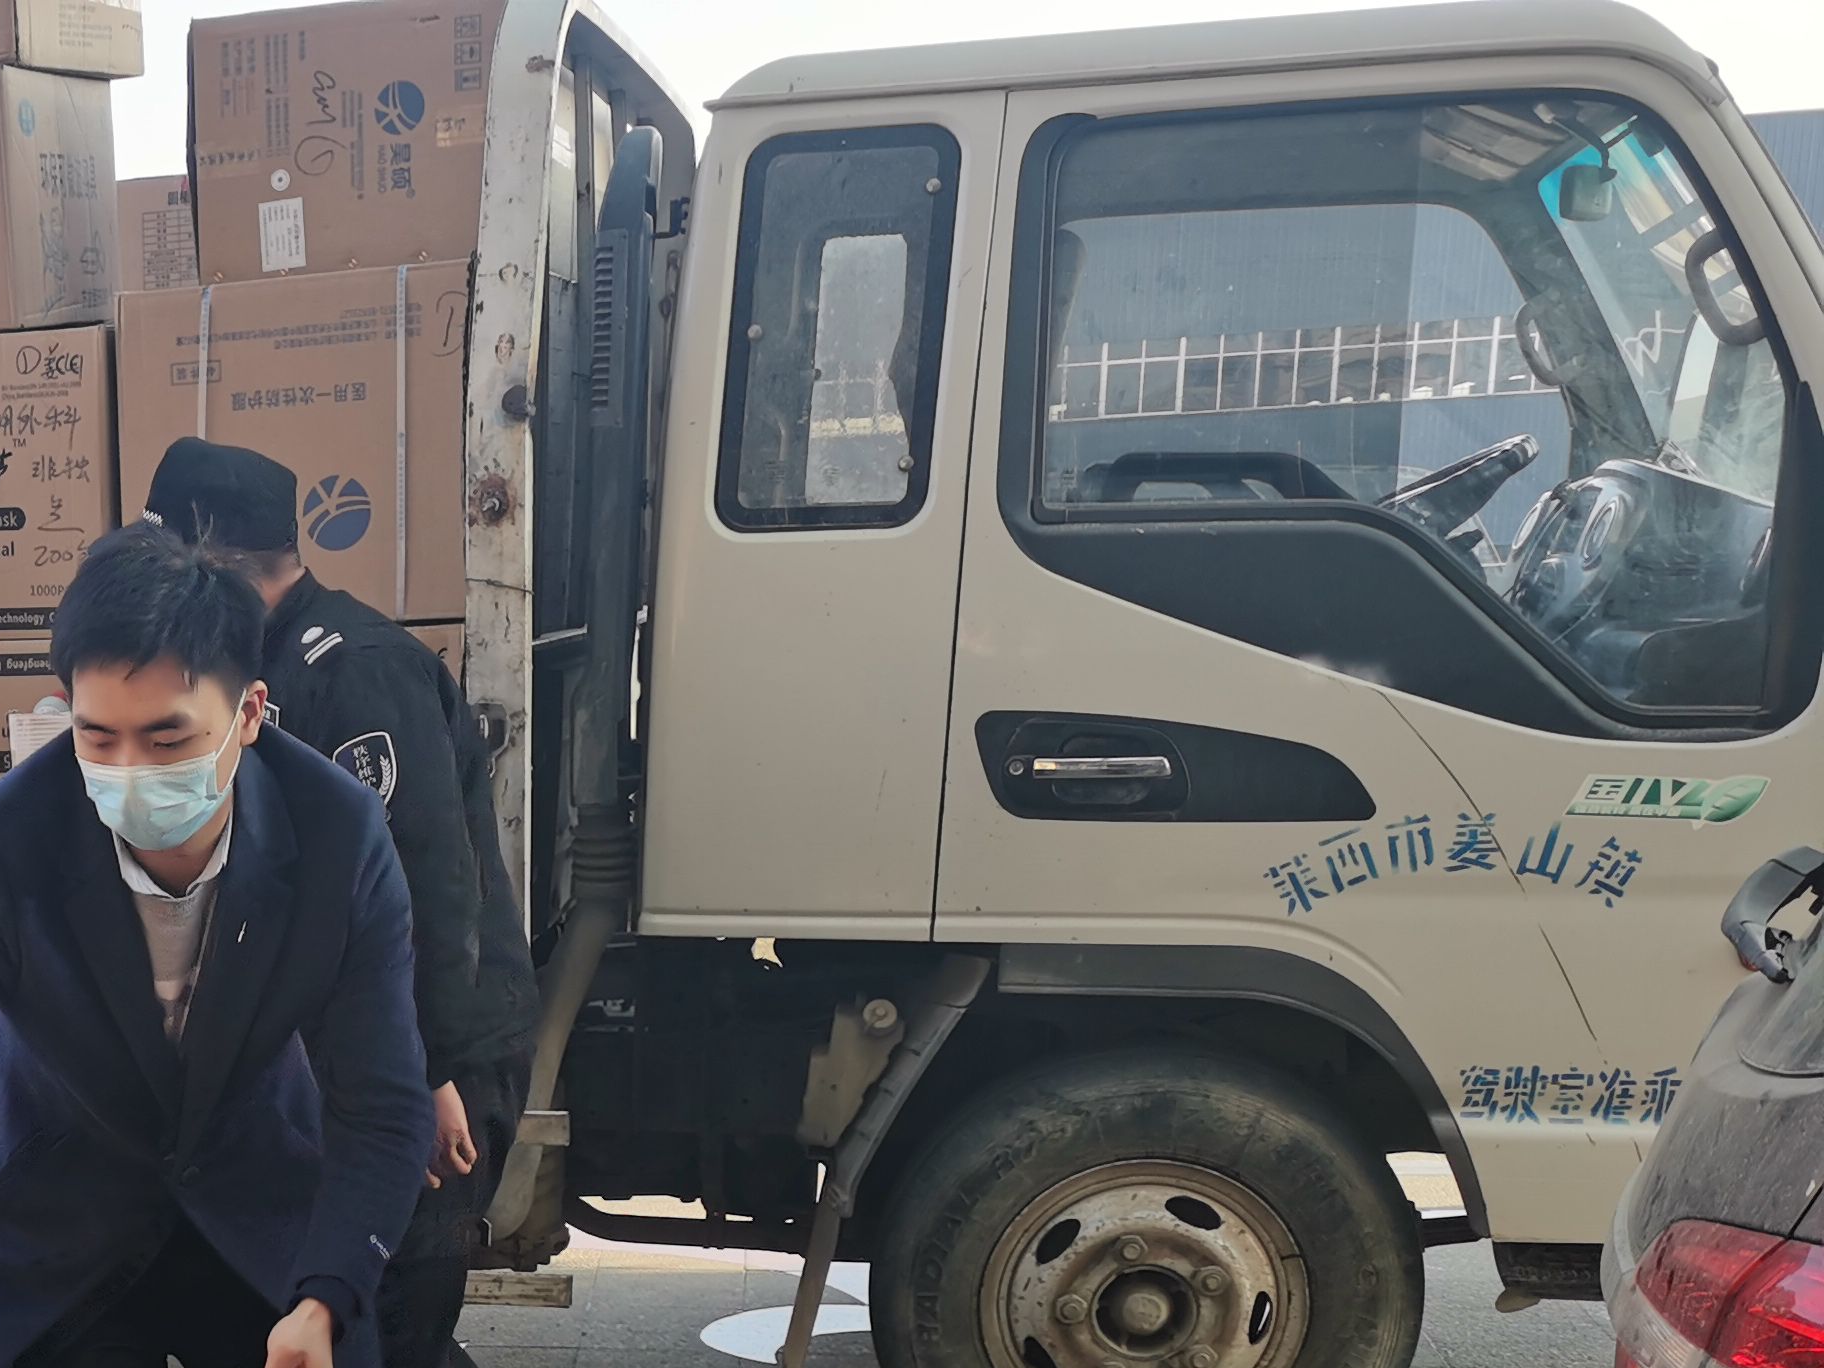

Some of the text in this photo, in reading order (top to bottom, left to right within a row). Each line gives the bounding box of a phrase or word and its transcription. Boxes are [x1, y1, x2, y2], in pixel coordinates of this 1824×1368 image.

[230, 382, 367, 410] 医用一次性防护服
[1263, 812, 1643, 917] 莱西市姜山镇
